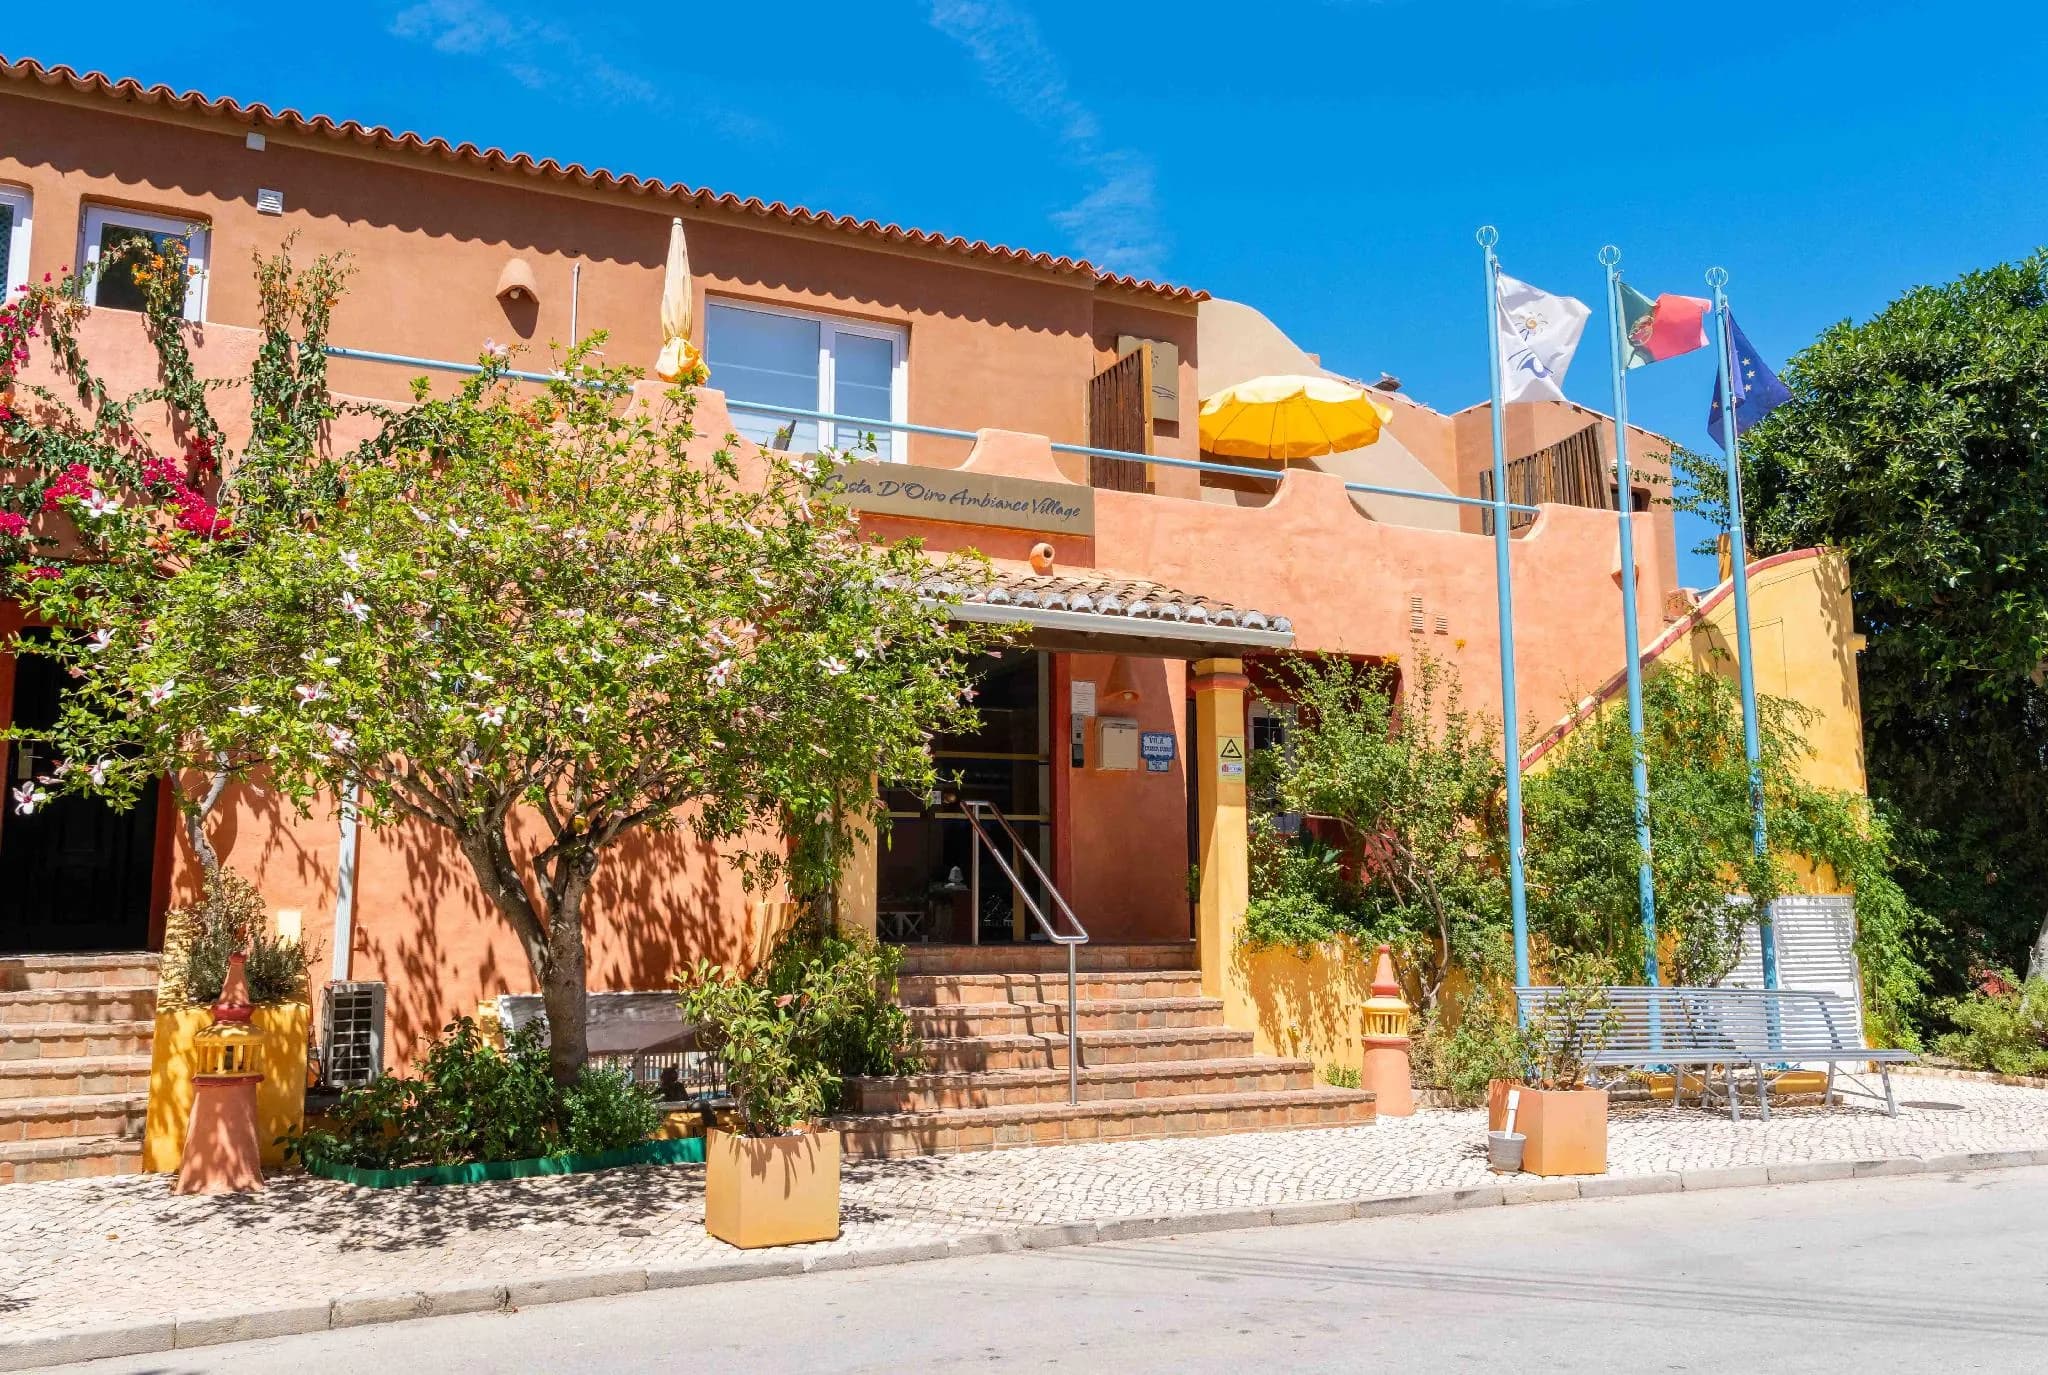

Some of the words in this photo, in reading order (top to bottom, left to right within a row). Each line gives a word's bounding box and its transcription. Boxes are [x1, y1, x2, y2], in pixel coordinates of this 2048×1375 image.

[876, 480, 946, 502] D'Oiro
[949, 488, 1029, 512] Ambiance
[1032, 497, 1080, 521] Village
